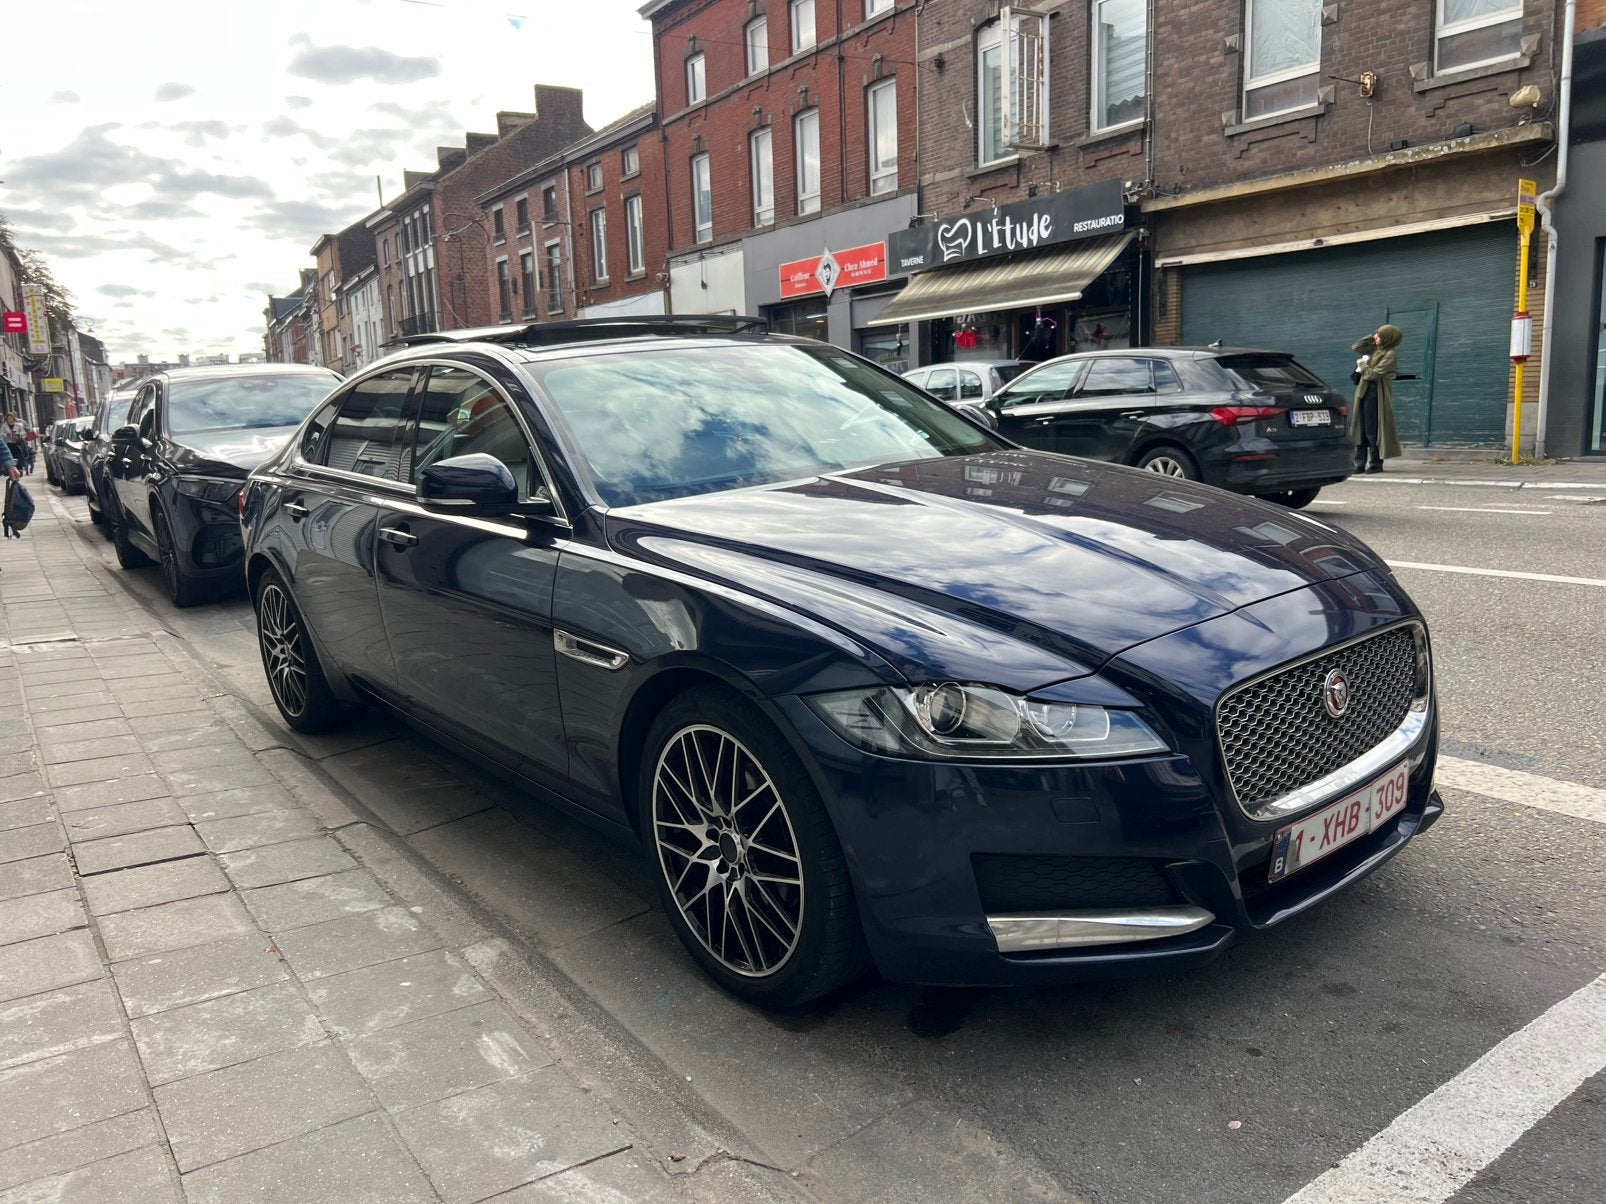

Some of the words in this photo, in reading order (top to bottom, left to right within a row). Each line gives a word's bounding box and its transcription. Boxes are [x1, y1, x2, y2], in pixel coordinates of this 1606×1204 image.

[976, 206, 1053, 255] L'Étude
[1073, 214, 1124, 233] RESTAURATIO
[844, 262, 858, 272] Chez
[900, 255, 924, 268] TAVERNE
[1274, 856, 1284, 874] B
